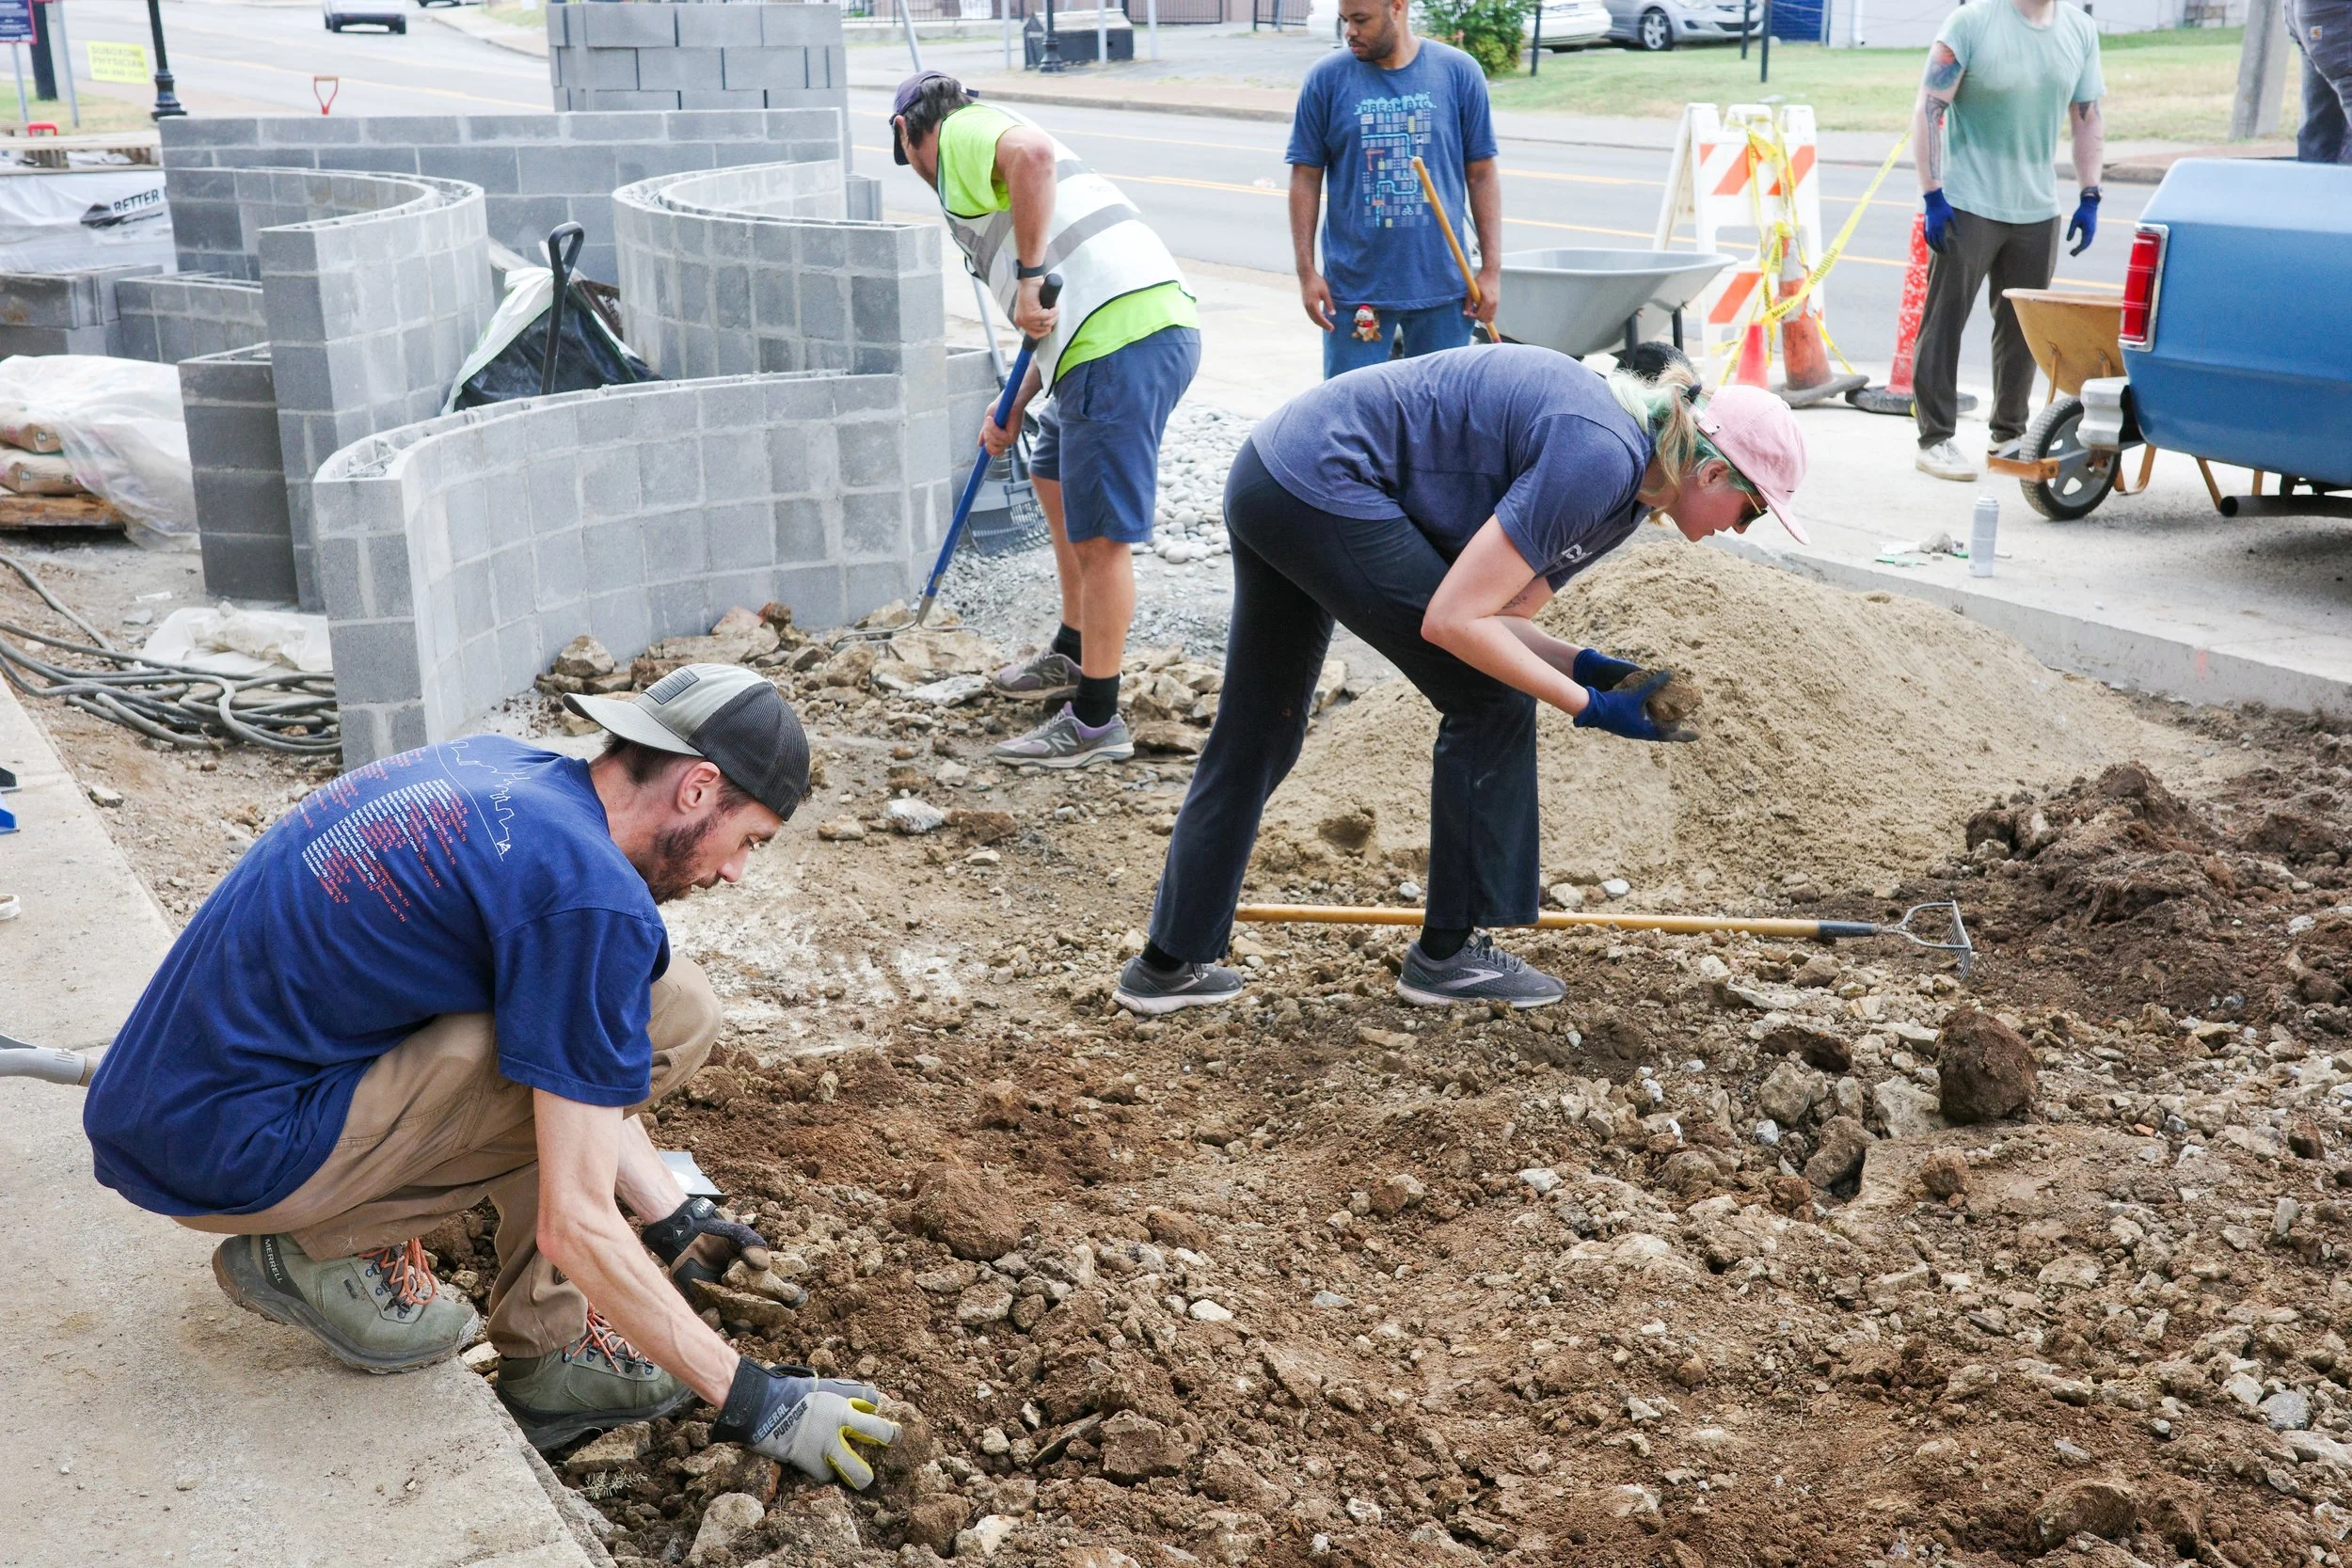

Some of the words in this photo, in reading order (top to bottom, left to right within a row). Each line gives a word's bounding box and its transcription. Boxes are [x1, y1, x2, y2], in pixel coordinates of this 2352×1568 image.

[1360, 103, 1402, 114] DREAM
[113, 189, 160, 214] BETTER
[392, 813, 411, 837] Distribution
[407, 836, 420, 852] Center
[355, 856, 369, 873] Master
[366, 871, 377, 883] Plan
[397, 912, 405, 922] TN
[358, 835, 366, 847] Long
[364, 845, 377, 861] Hollow
[402, 897, 410, 907] TN
[379, 878, 387, 886] TN
[264, 1238, 283, 1284] MERRELL
[752, 1402, 790, 1443] GENERAL
[772, 1400, 809, 1441] PURPOSE
